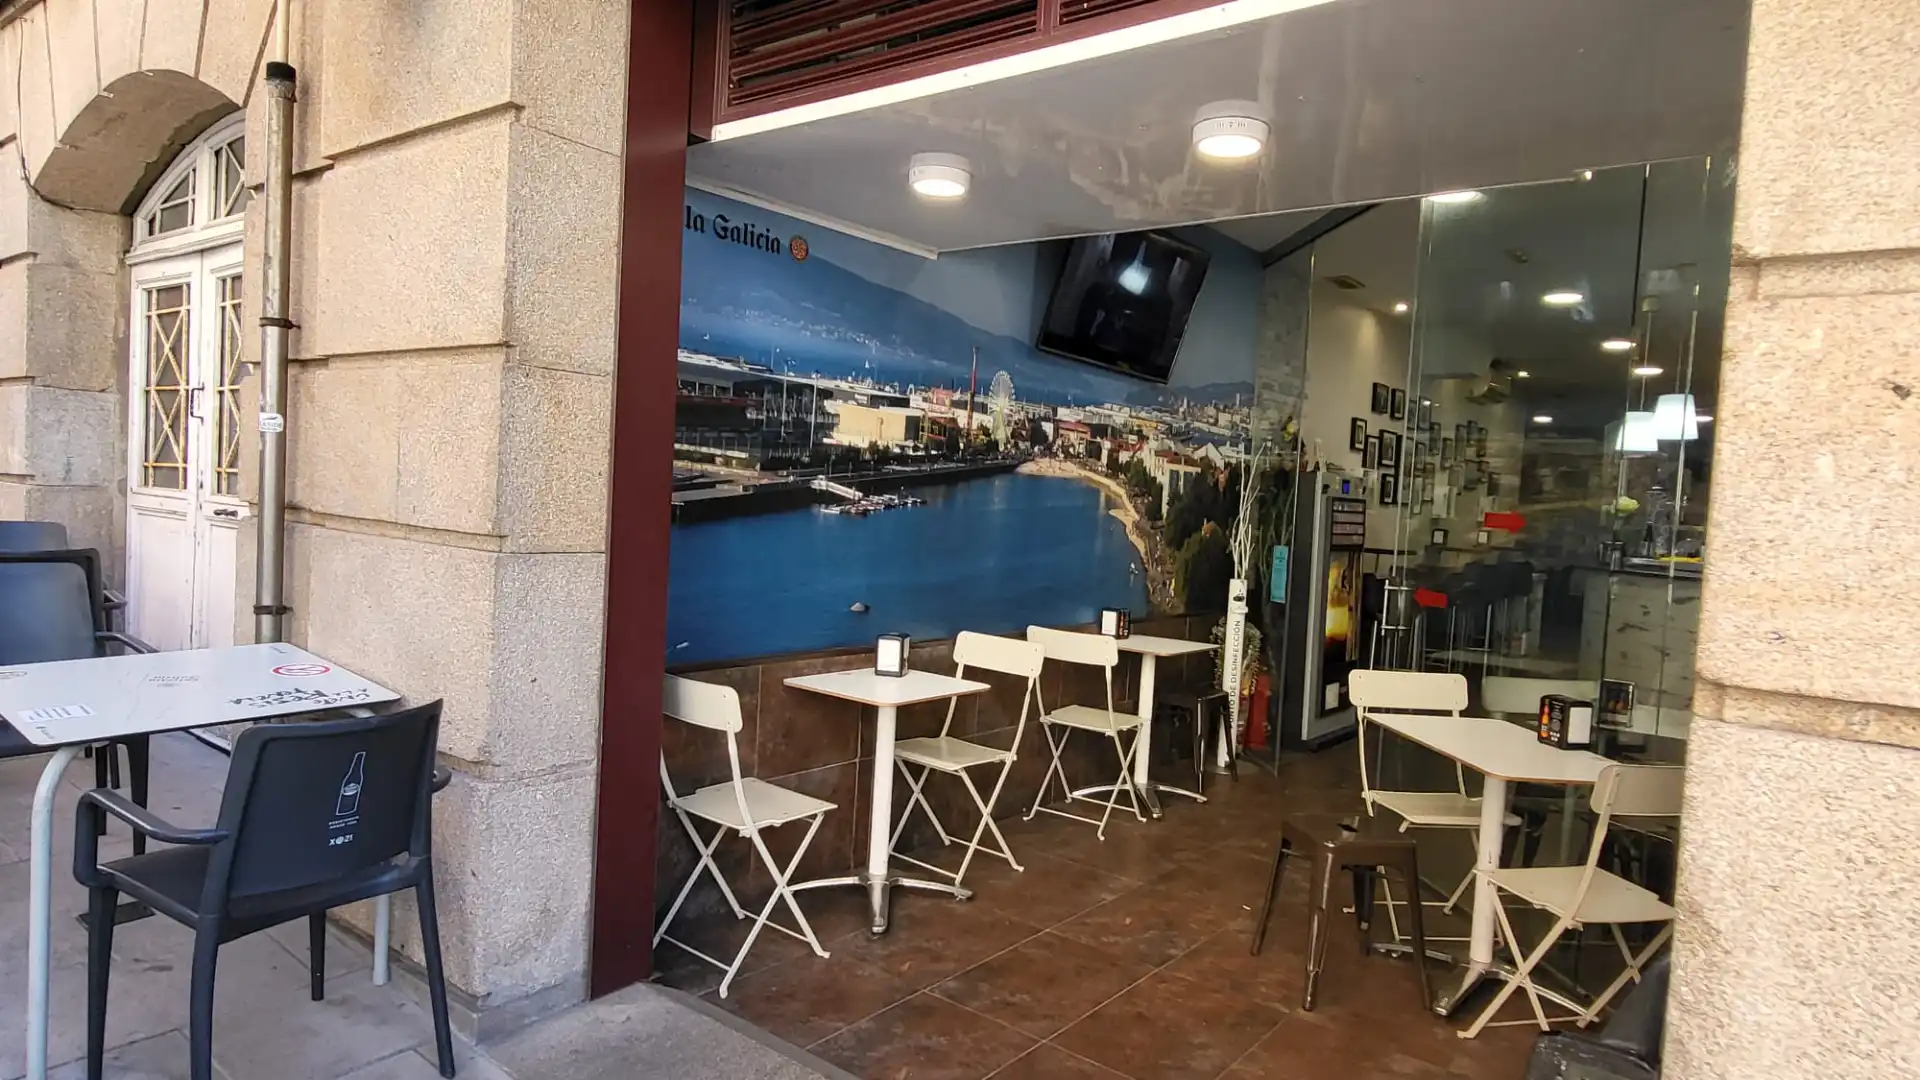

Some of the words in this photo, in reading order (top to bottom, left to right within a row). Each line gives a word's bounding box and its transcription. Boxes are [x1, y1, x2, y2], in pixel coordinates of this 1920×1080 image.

[713, 214, 780, 255] Galicia
[1231, 621, 1241, 683] DESINFECCIÓN
[1230, 686, 1237, 697] DE
